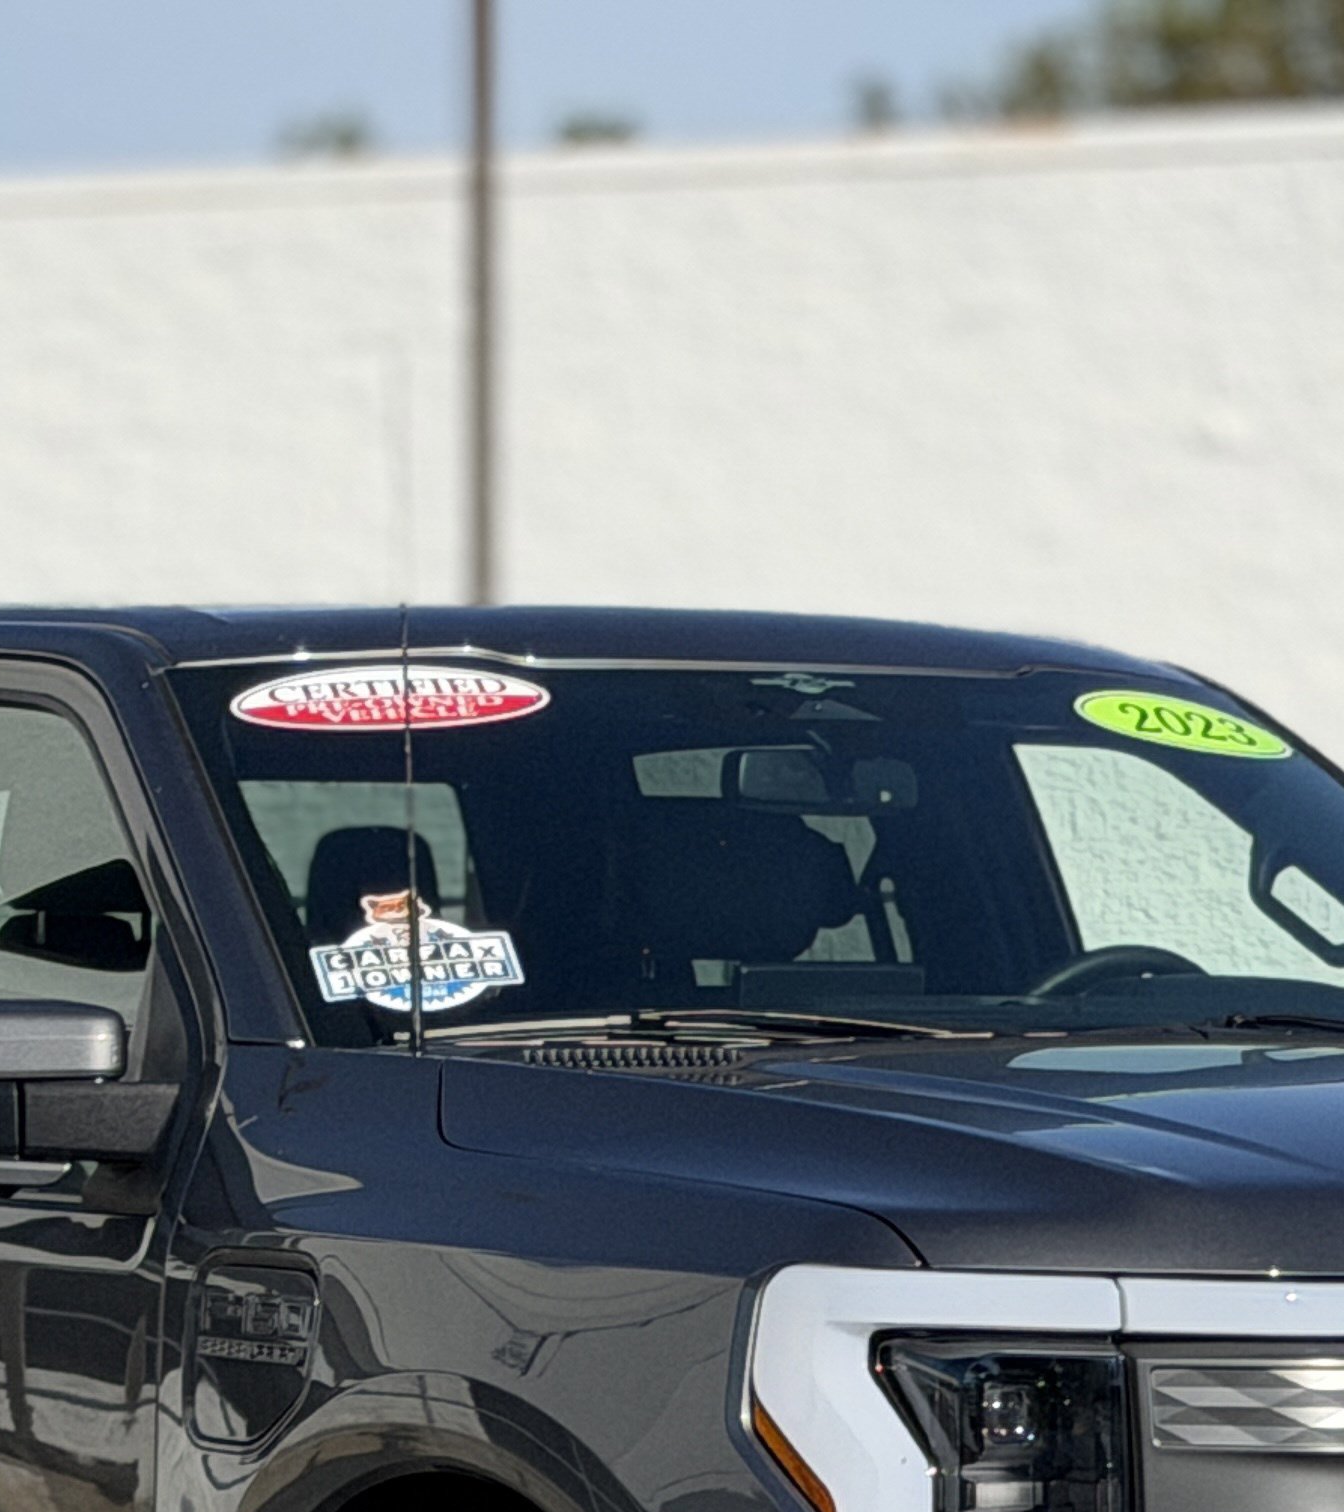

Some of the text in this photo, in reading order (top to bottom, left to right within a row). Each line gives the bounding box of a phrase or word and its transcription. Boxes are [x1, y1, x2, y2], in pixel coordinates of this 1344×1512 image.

[268, 678, 507, 704] CERTIFIED
[1118, 703, 1258, 747] 2023
[329, 941, 500, 970] CARFAX
[366, 961, 505, 987] OWNER
